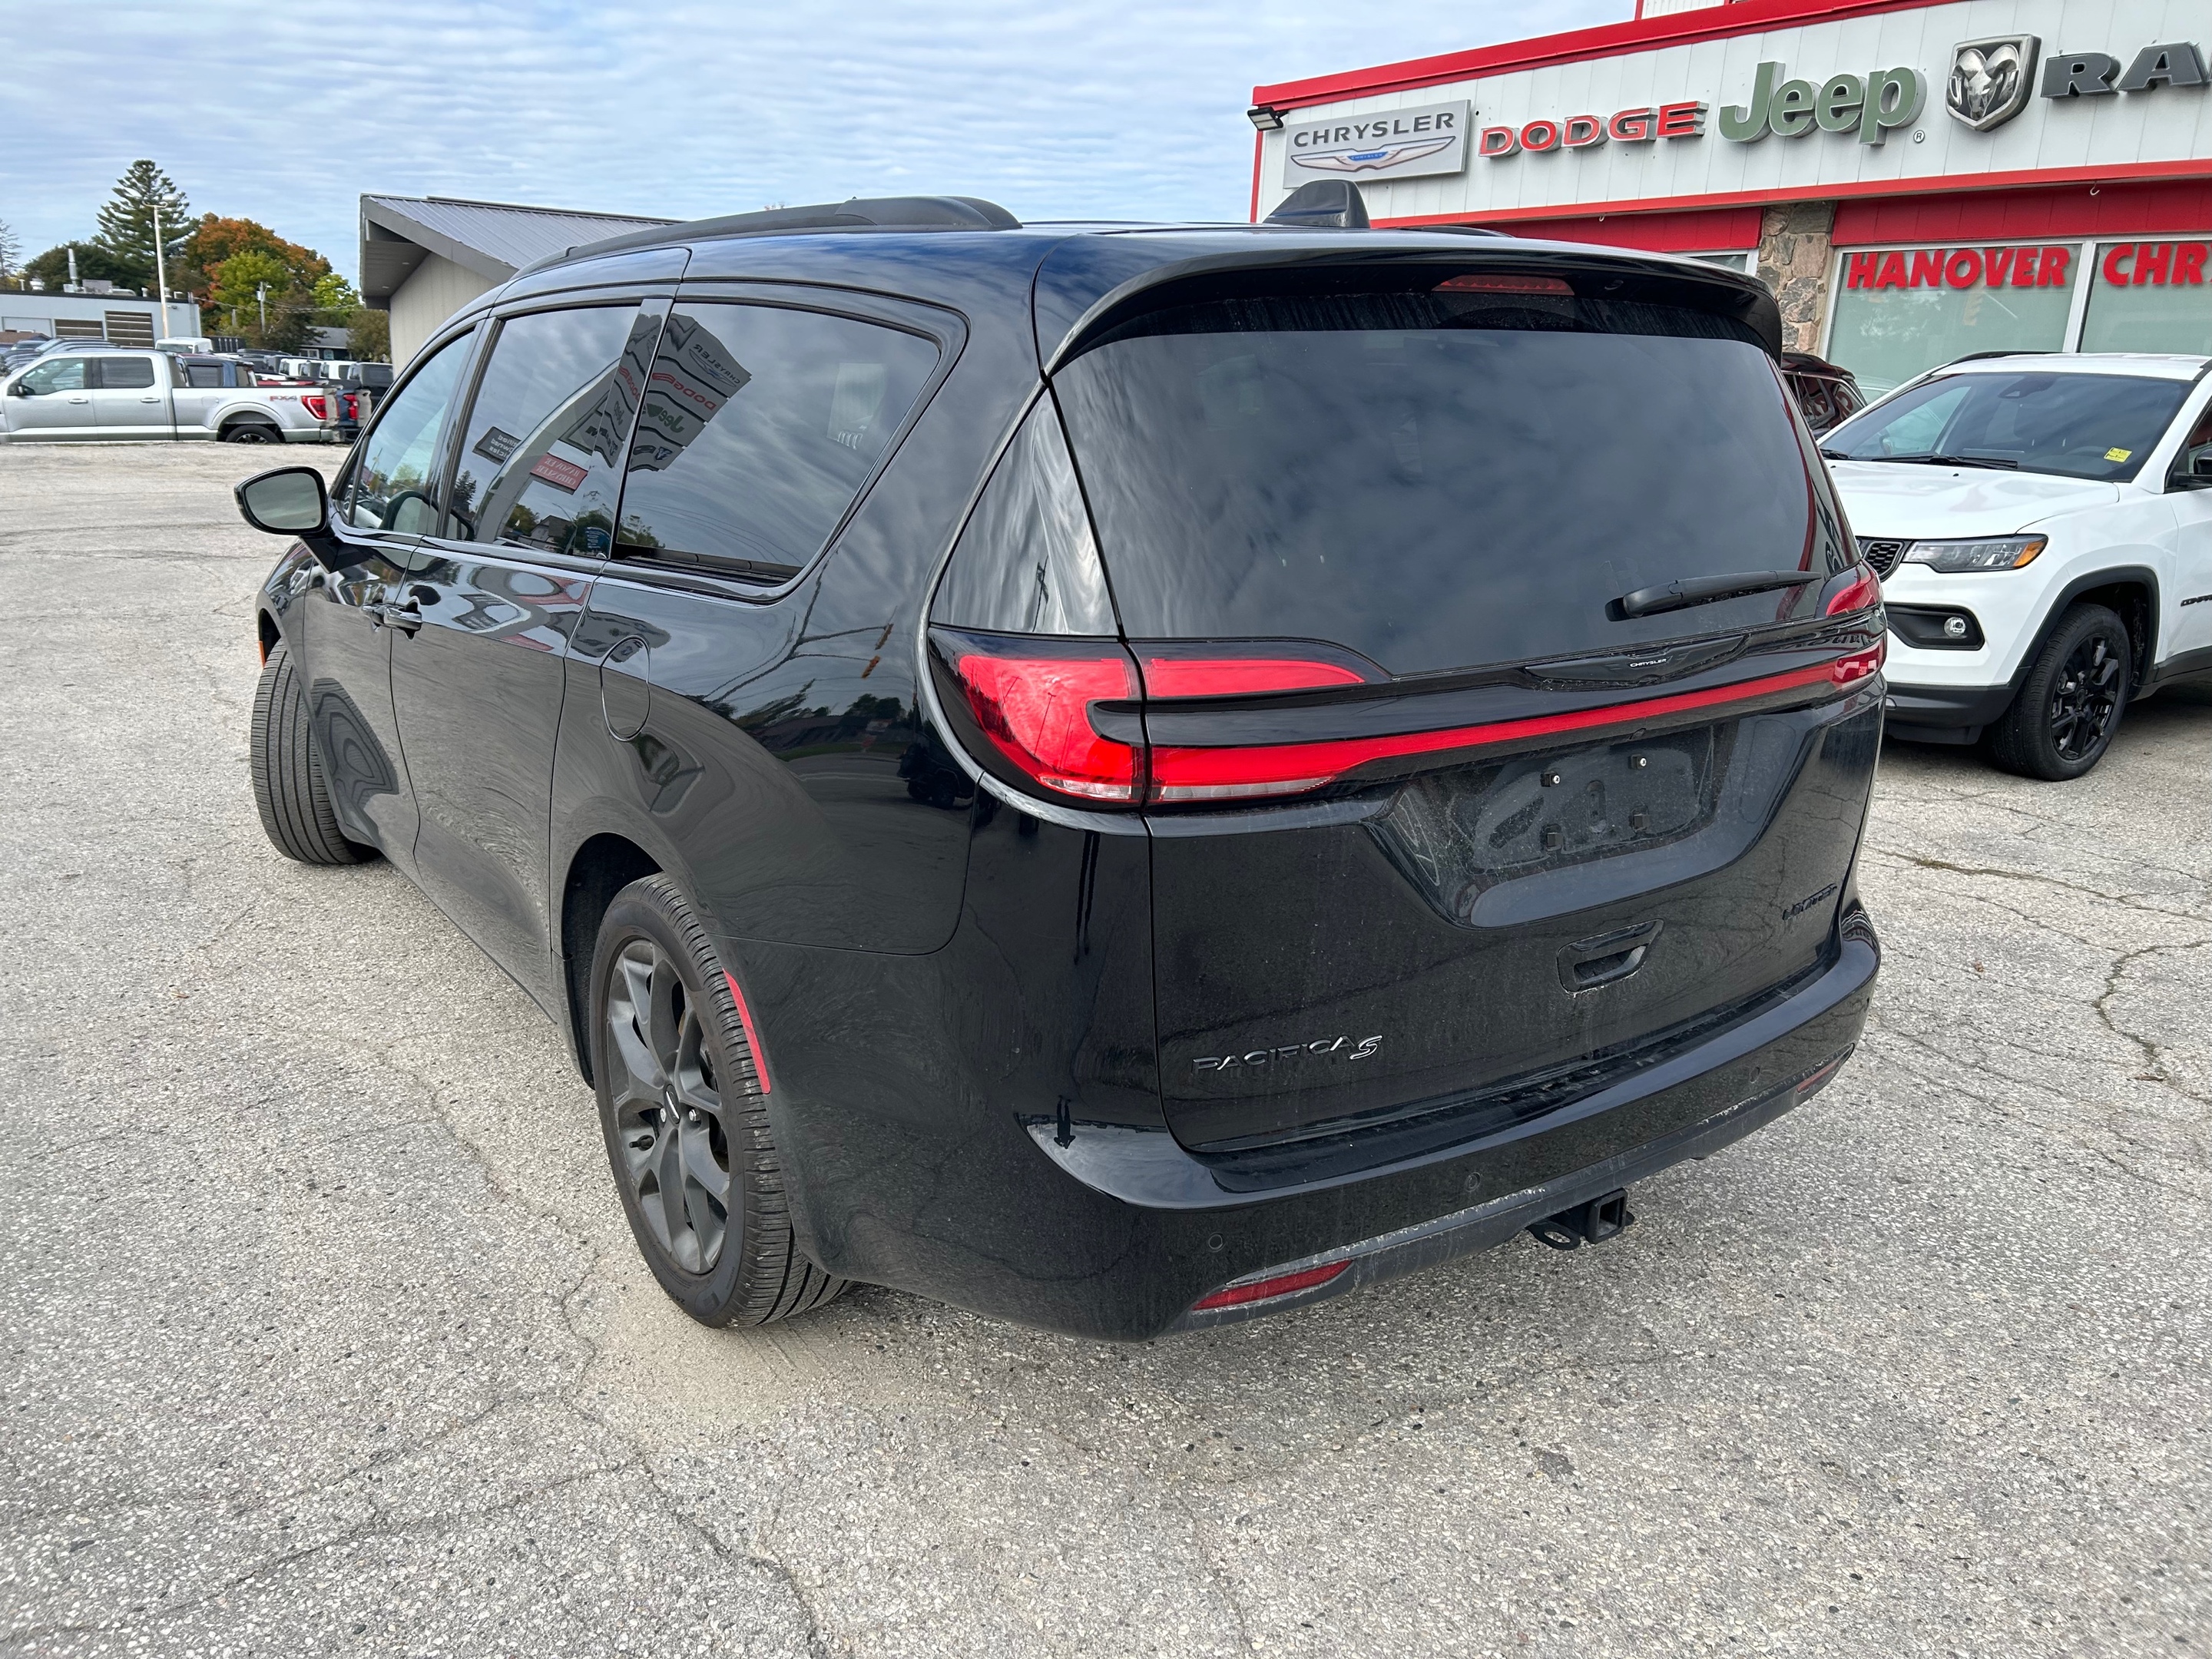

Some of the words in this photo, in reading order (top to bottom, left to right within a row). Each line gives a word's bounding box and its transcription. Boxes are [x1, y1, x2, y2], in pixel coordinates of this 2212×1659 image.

[2040, 40, 2212, 100] RA
[1718, 61, 1926, 146] Jeep
[1293, 112, 1455, 147] CHRYSLER
[1479, 101, 1709, 158] DODGE
[1846, 246, 2071, 289] HANOVER
[2102, 242, 2212, 286] CHR
[1629, 658, 1667, 667] CHRYSLER
[1191, 1035, 1355, 1074] PACIFICA
